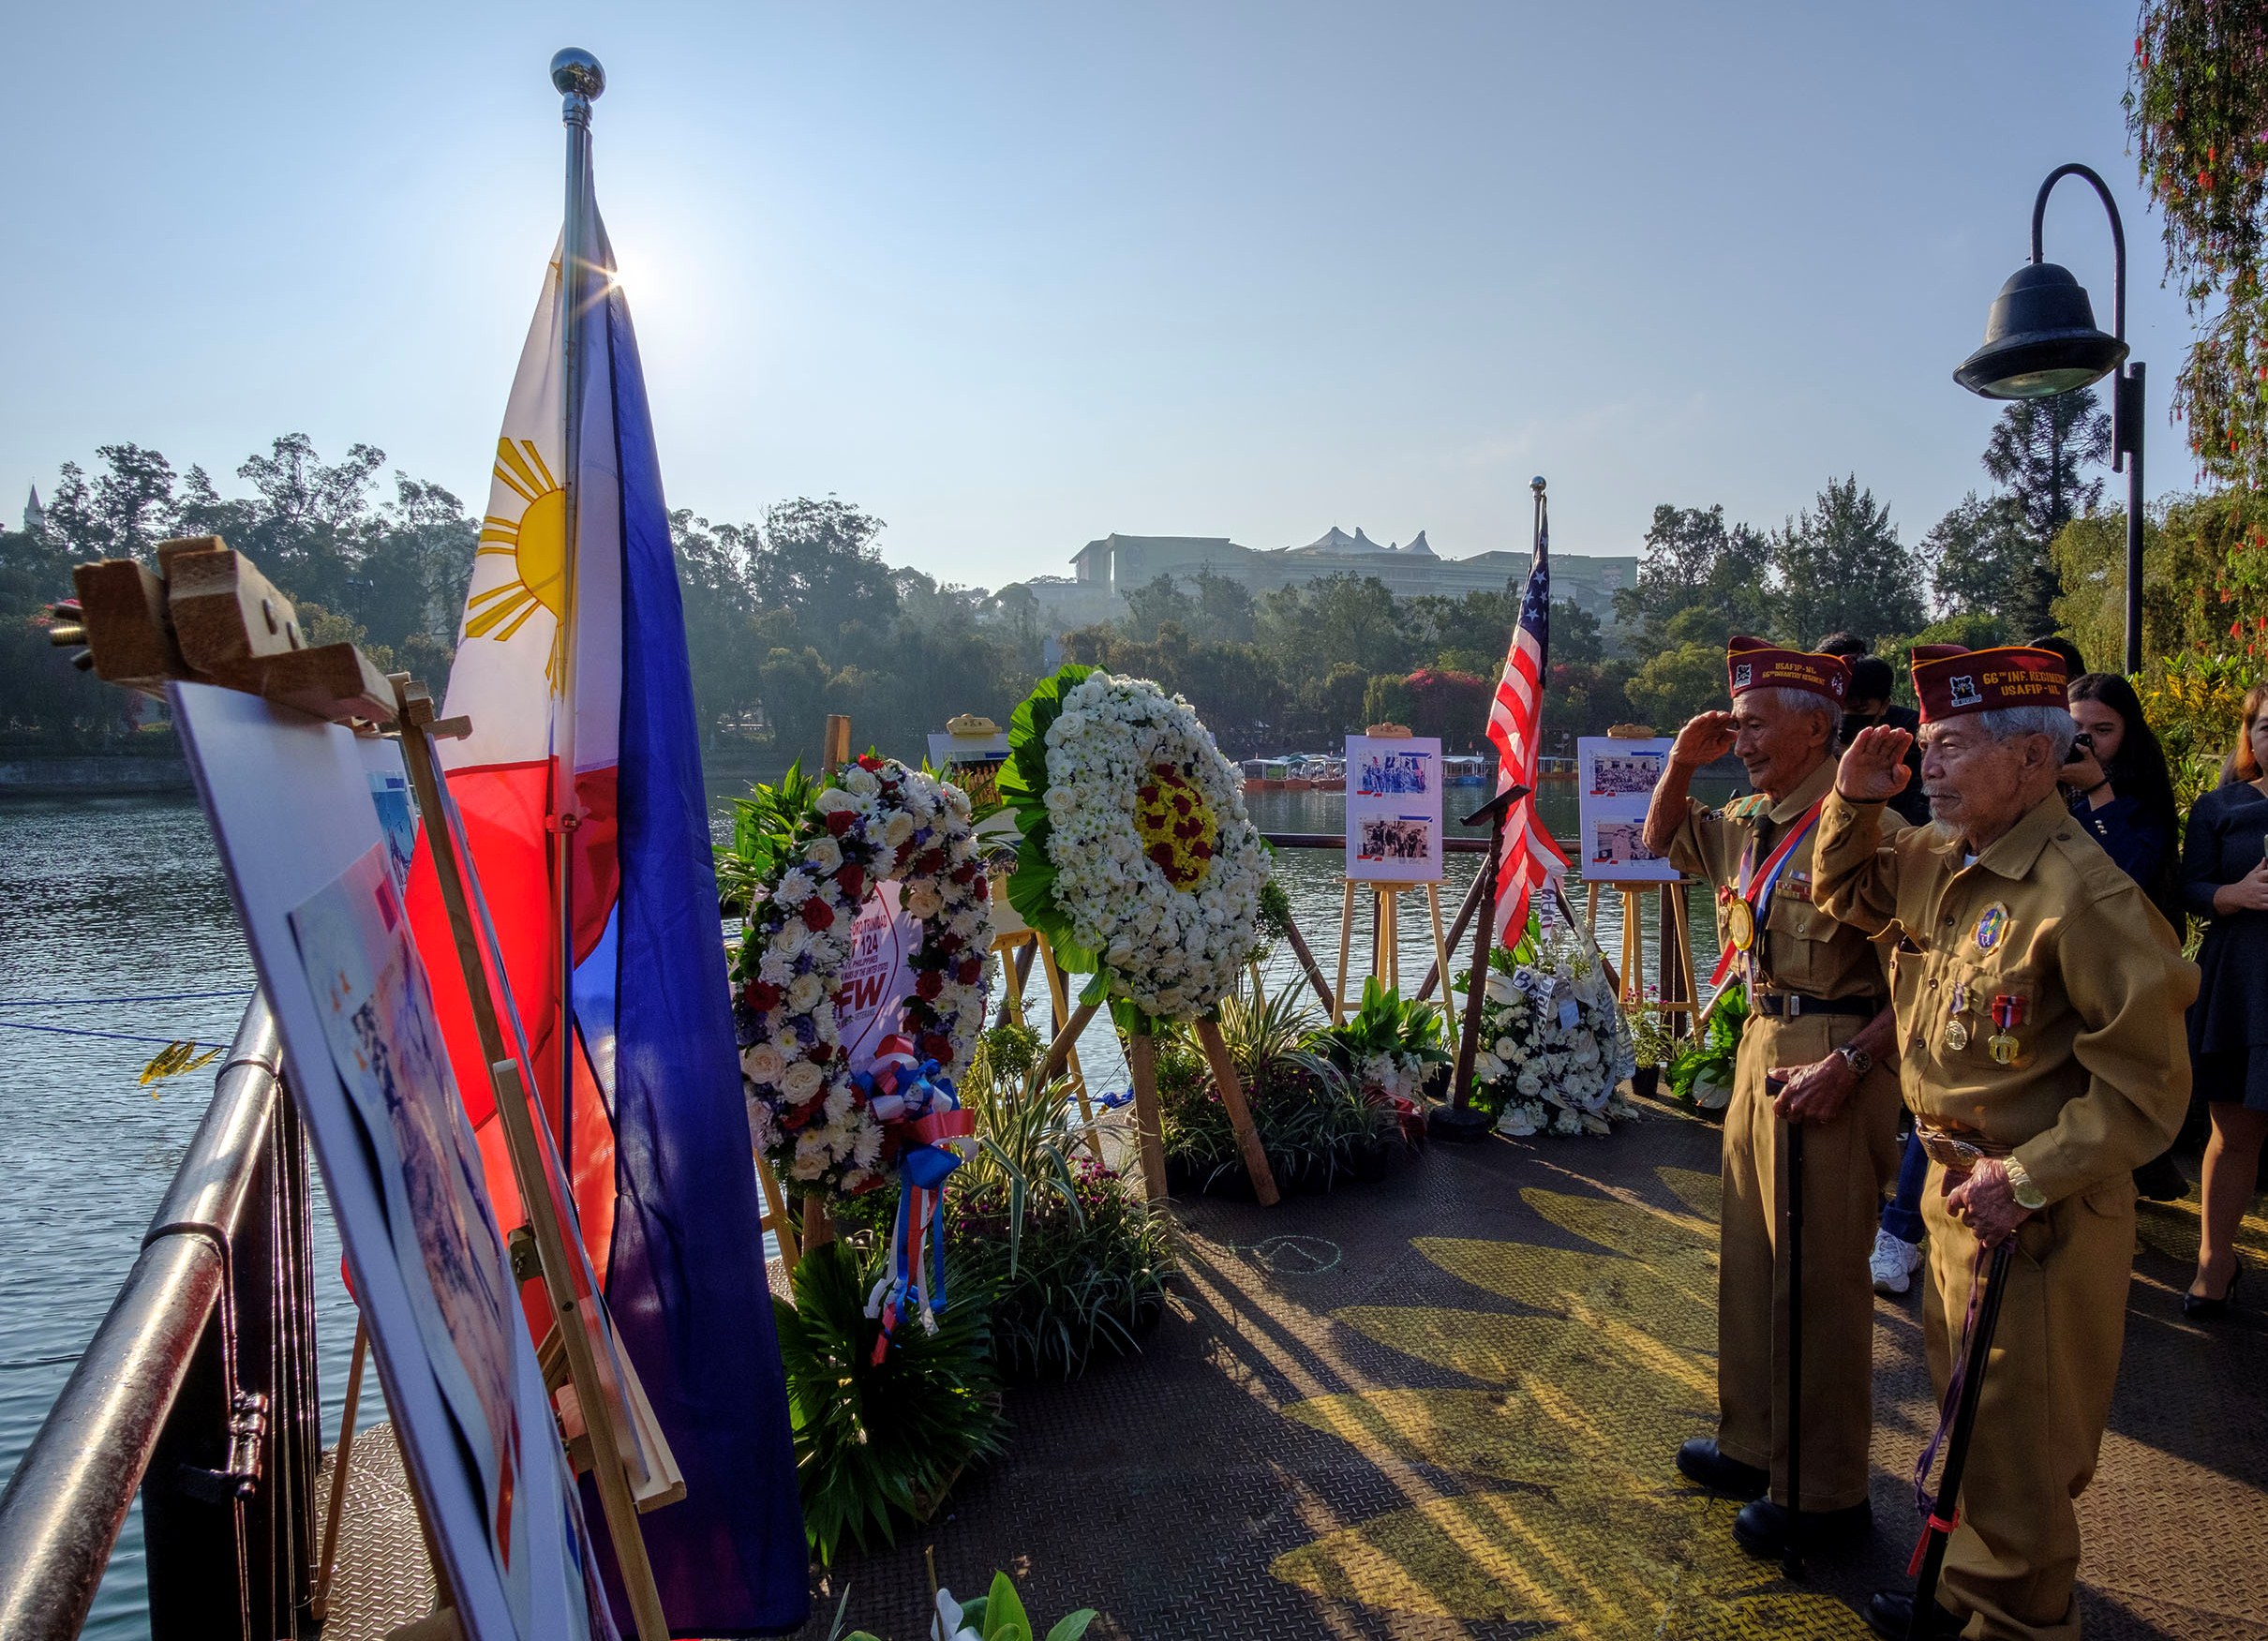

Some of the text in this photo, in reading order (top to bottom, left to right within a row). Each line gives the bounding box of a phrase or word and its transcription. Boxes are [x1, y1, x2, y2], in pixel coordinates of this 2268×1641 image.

[2007, 670, 2028, 682] INF.
[2029, 671, 2067, 685] REGIMENT
[861, 932, 878, 956] 124
